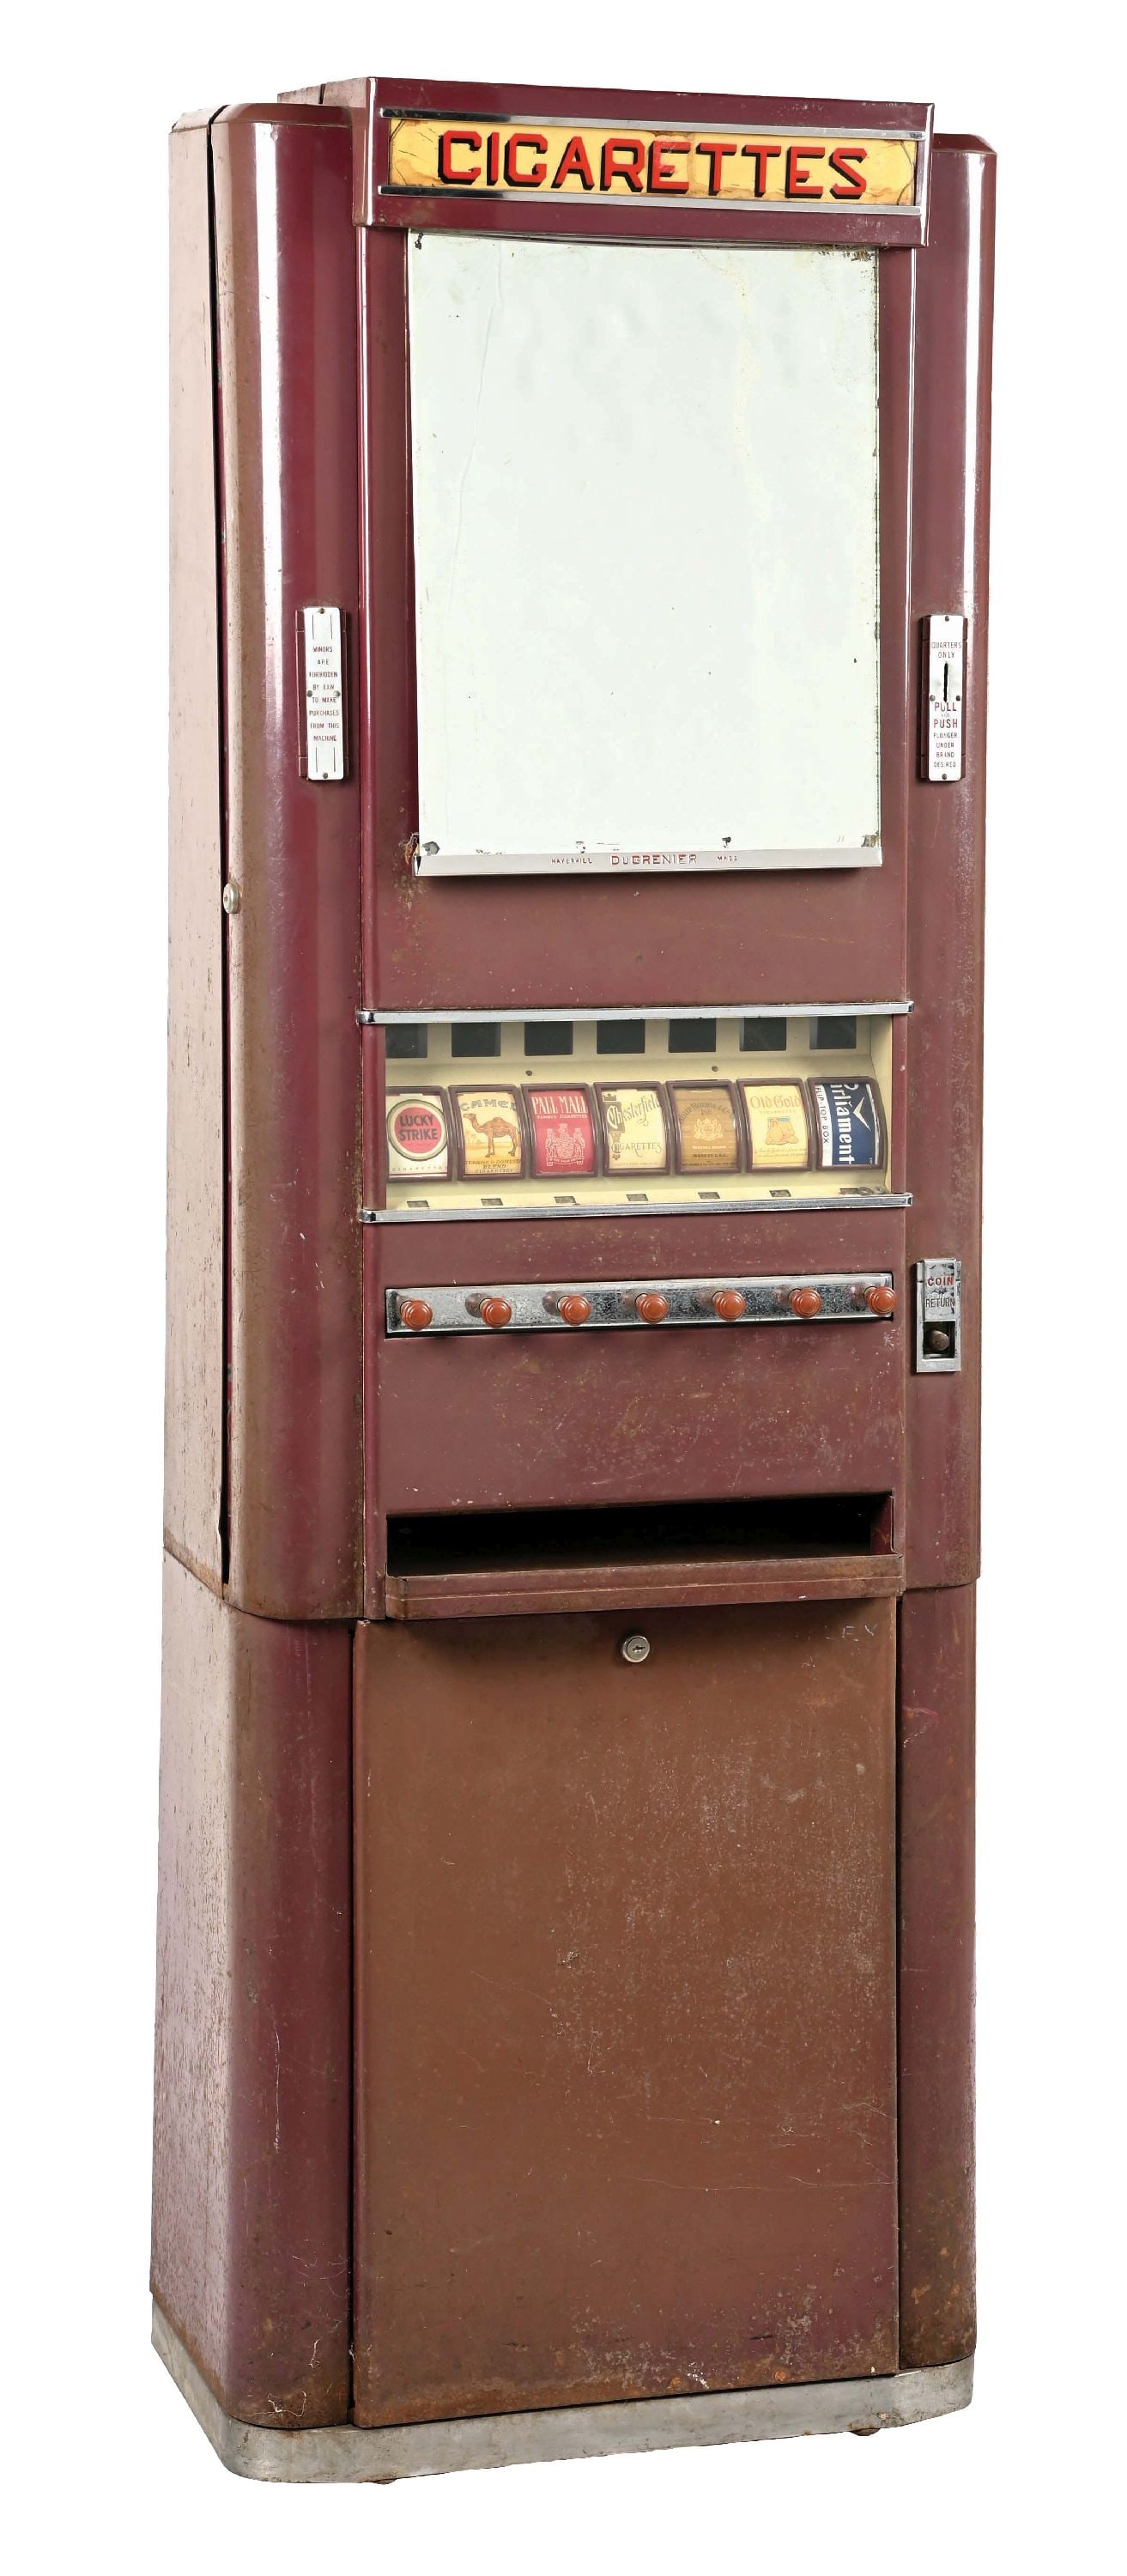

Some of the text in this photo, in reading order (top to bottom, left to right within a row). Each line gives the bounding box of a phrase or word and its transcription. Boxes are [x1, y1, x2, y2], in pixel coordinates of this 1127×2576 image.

[438, 130, 868, 199] CIGARETTES
[935, 702, 957, 712] PULL
[934, 719, 958, 728] PUSH
[531, 1096, 588, 1115] PALL MALL
[750, 1095, 802, 1109] Old Gold
[607, 1093, 660, 1129] Chesterfield
[399, 1115, 433, 1127] LUCKY
[399, 1128, 438, 1141] STRIKE
[927, 1277, 954, 1286] COIN
[925, 1297, 955, 1308] RETURN
